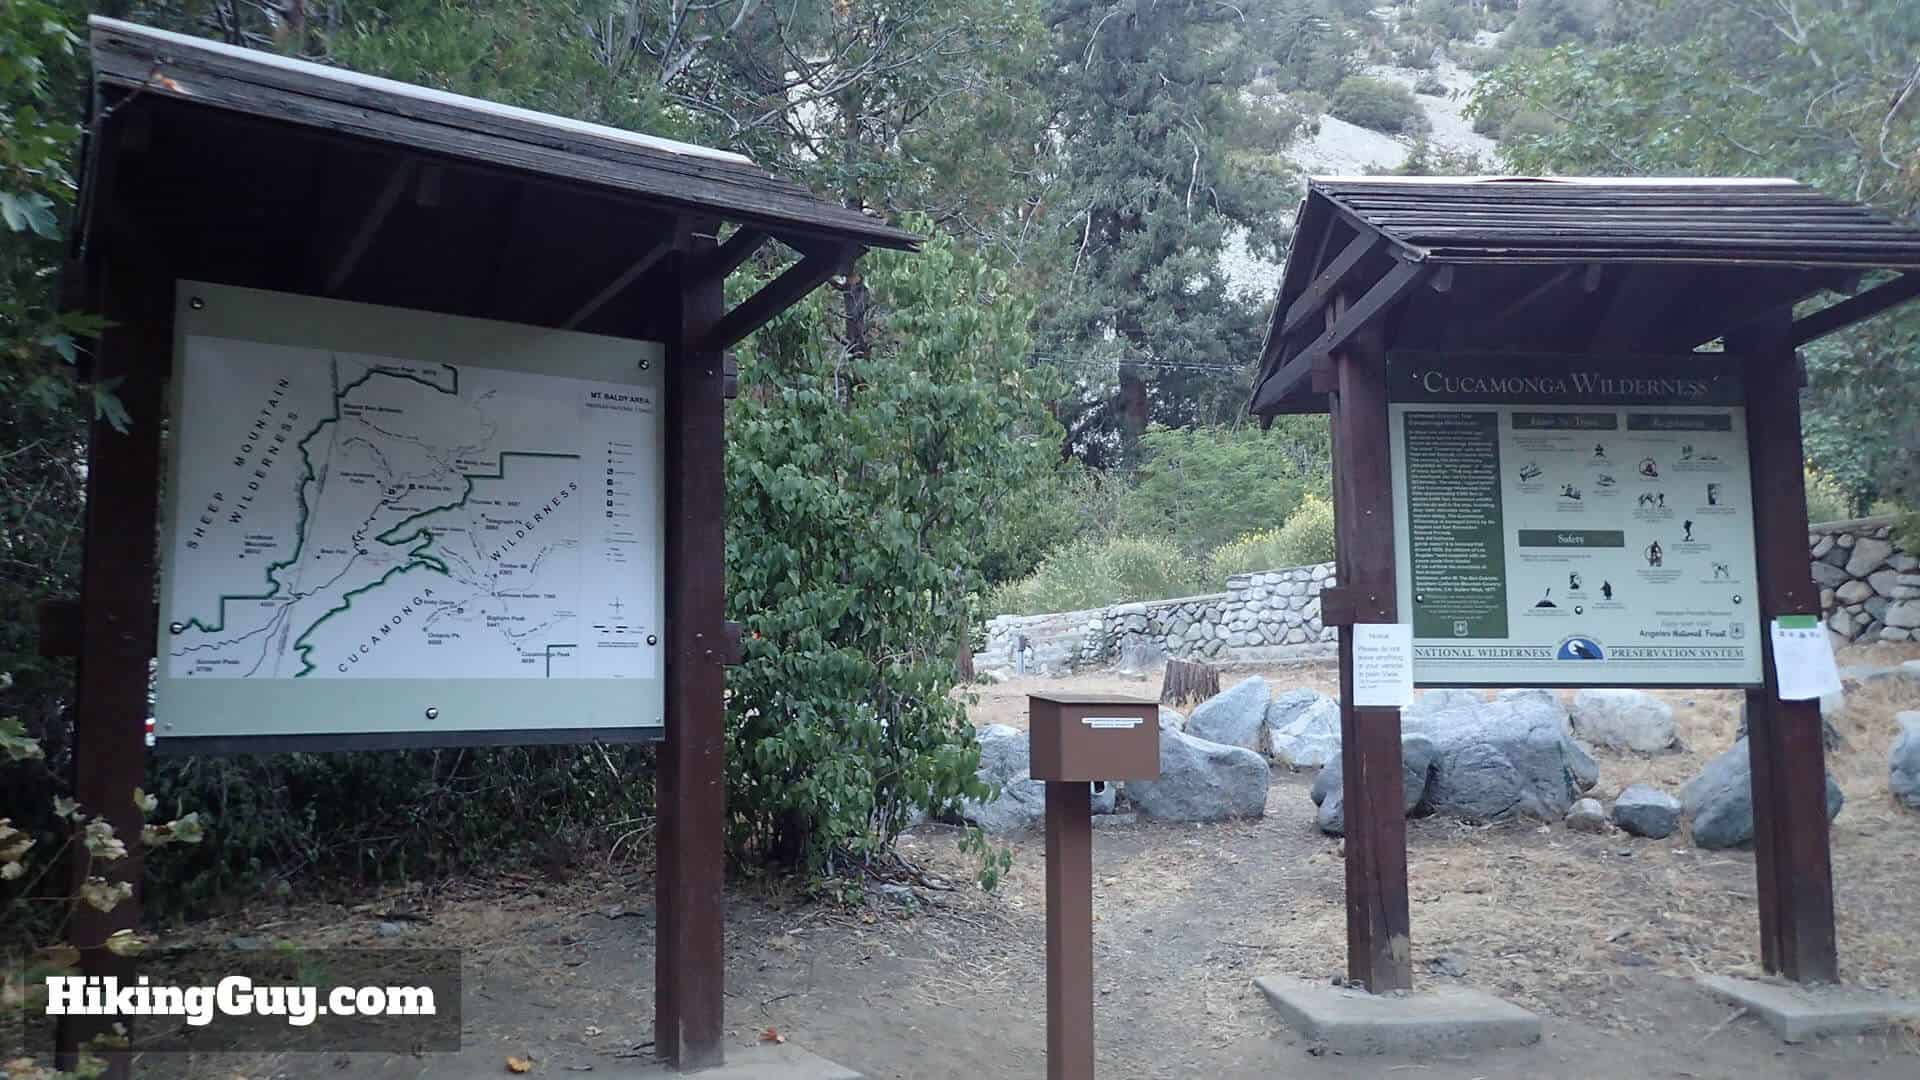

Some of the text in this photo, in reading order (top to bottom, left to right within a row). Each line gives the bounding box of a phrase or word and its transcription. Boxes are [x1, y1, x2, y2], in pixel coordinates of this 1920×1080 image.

[187, 377, 289, 549] SHEEP MOUNTAIN
[229, 411, 298, 524] WILDERNESS
[490, 481, 577, 561] WILDERNESS
[1557, 534, 1585, 546] Safety
[338, 588, 434, 673] CUCAMONGA
[1415, 648, 1551, 658] NATIONAL WILDERNESS
[1611, 648, 1744, 658] PRESERVATION SYSTEM
